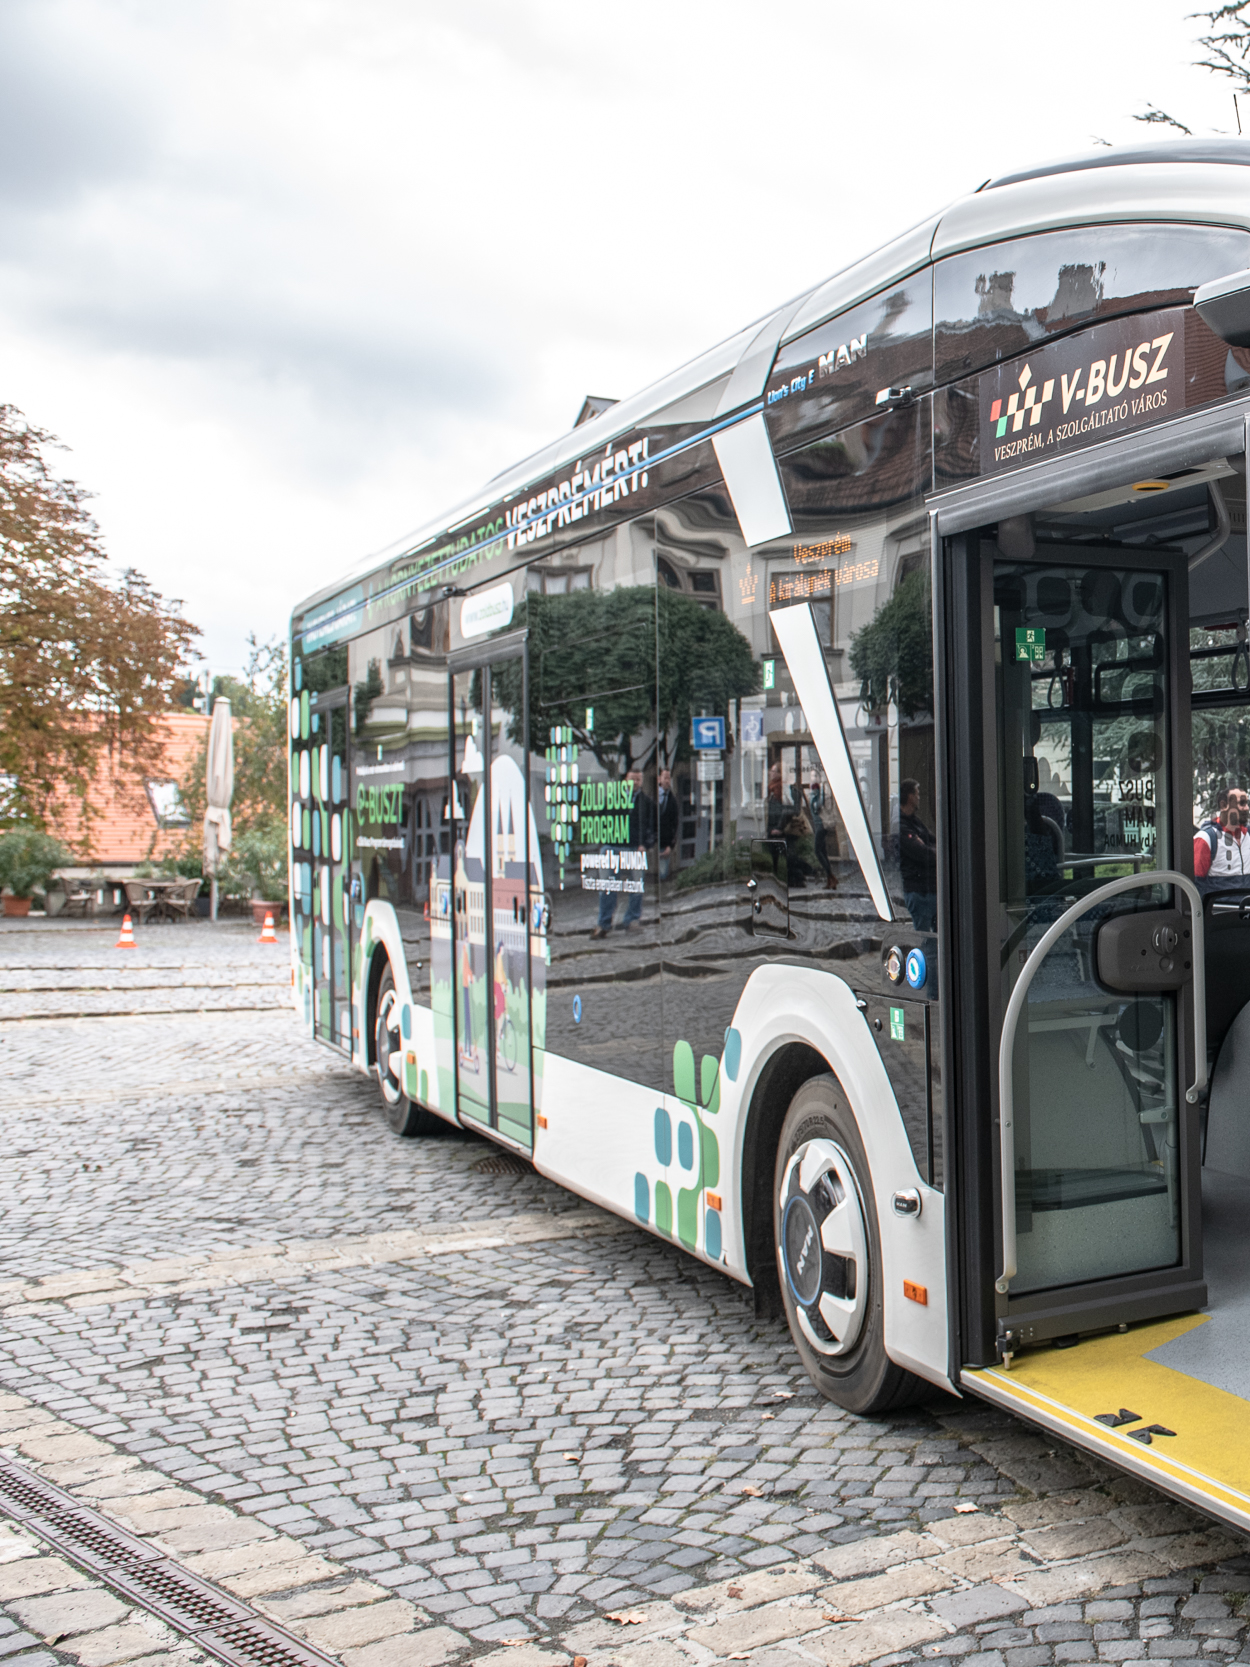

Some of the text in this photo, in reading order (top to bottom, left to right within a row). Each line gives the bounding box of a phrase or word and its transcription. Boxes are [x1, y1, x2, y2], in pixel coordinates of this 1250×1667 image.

[818, 333, 867, 378] MAN
[1061, 332, 1174, 415] V-BUSZ
[767, 368, 815, 405] Lion's City E
[994, 389, 1168, 462] VESZPRÉM, A SZOLGÁLTATÓ VÁROS
[505, 437, 649, 550] VESZPRÉMÉRT!
[793, 532, 852, 566] Veszprém
[769, 581, 777, 604] A
[834, 559, 879, 586] városa
[356, 782, 405, 826] e-BUSZT
[606, 779, 635, 810] BUSZ
[580, 814, 630, 844] PROGRAM
[581, 850, 648, 874] powered by HUMDA
[796, 1224, 814, 1275] MAN
